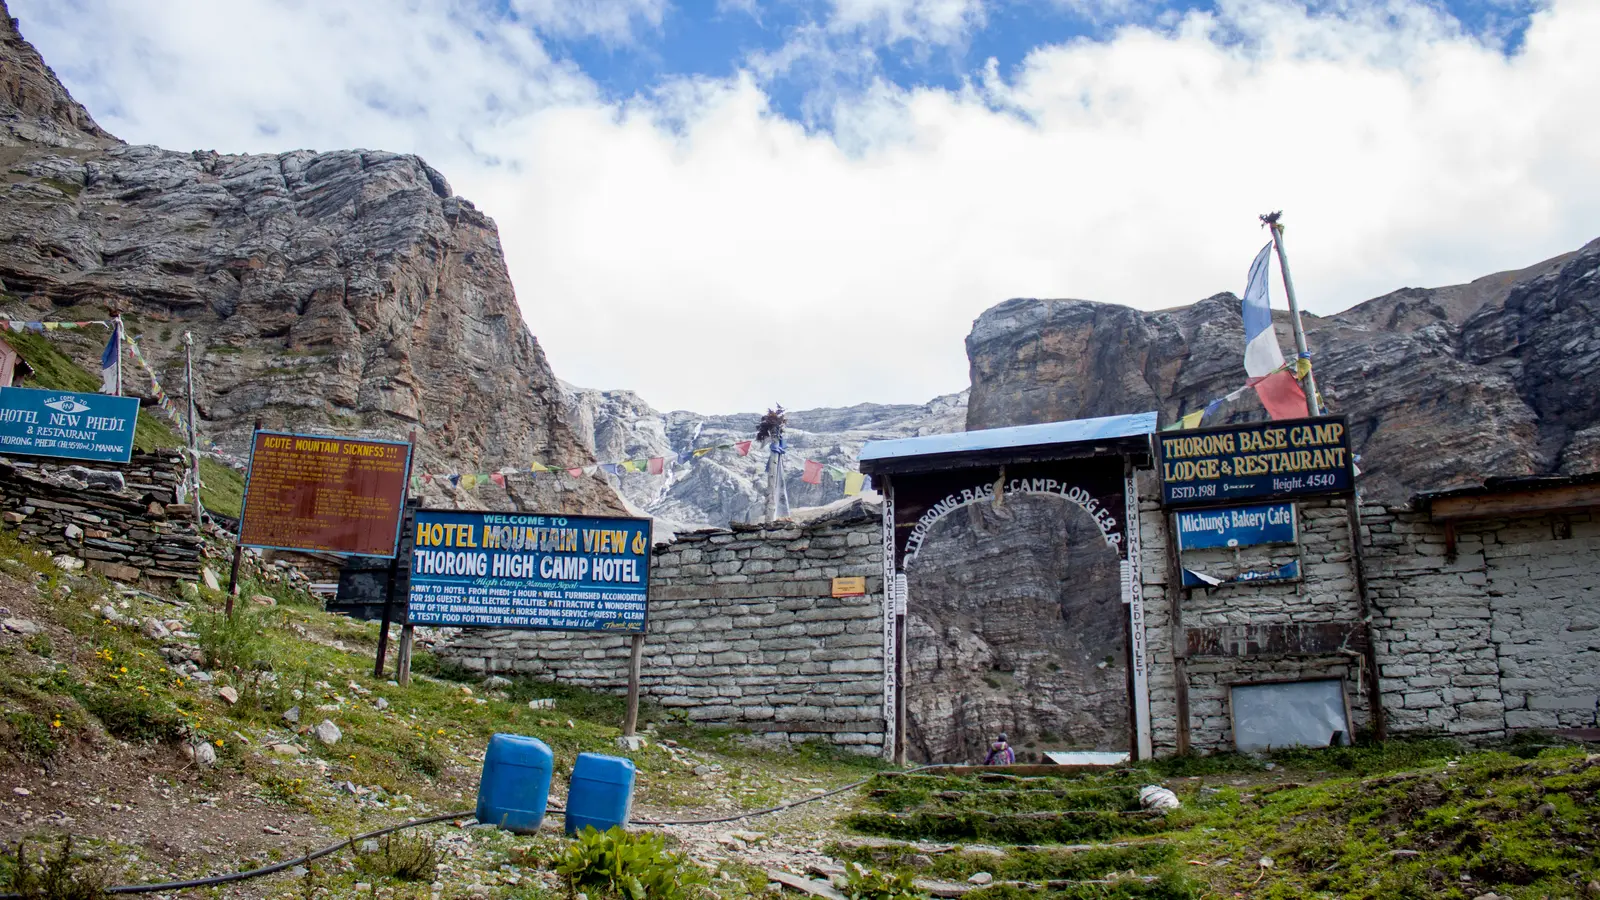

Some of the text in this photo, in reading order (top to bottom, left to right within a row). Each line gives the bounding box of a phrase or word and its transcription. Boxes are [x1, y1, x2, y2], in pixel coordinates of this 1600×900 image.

[0, 408, 126, 431] HOTEL NEW PHEDI
[27, 425, 97, 441] & RESTAURANT
[1162, 423, 1344, 459] THORONG BASE CAMP
[95, 443, 123, 453] MANANG
[264, 437, 292, 449] ACUTE
[295, 440, 340, 454] MOUNTAIN
[1163, 447, 1346, 483] LODGE & RESTAURANT
[1306, 473, 1336, 487] 4540
[483, 515, 568, 526] WELCOME TO
[1181, 507, 1290, 535] Michung's Bakery Cafe
[415, 522, 647, 555] HOTEL MOUNTAIN VIEW &
[414, 549, 640, 582] THORONG HIGH CAMP HOTEL
[436, 595, 461, 603] GUESTS
[468, 596, 480, 604] ALL
[482, 597, 510, 605] ELECTRIC
[512, 598, 547, 607] FACILITIES
[553, 600, 595, 608] ATTRACTIVE
[444, 587, 466, 595] HOTEL
[468, 587, 487, 595] FROM
[518, 590, 537, 598] HOUR
[543, 591, 562, 599] WELL
[564, 592, 601, 600] FURNISHED
[408, 612, 416, 620] &
[442, 613, 460, 621] FOOD
[462, 614, 475, 622] FOR
[476, 615, 502, 623] TWELVE
[503, 616, 528, 624] MONTH
[409, 603, 425, 611] VIEW
[437, 604, 449, 612] THE
[489, 606, 510, 614] RANGE
[516, 607, 537, 615] HORSE
[538, 609, 560, 617] RIDING
[561, 610, 588, 618] SERVICE
[594, 611, 617, 619] GUESTS
[623, 612, 644, 620] CLEAN
[1134, 622, 1143, 677] TOILET
